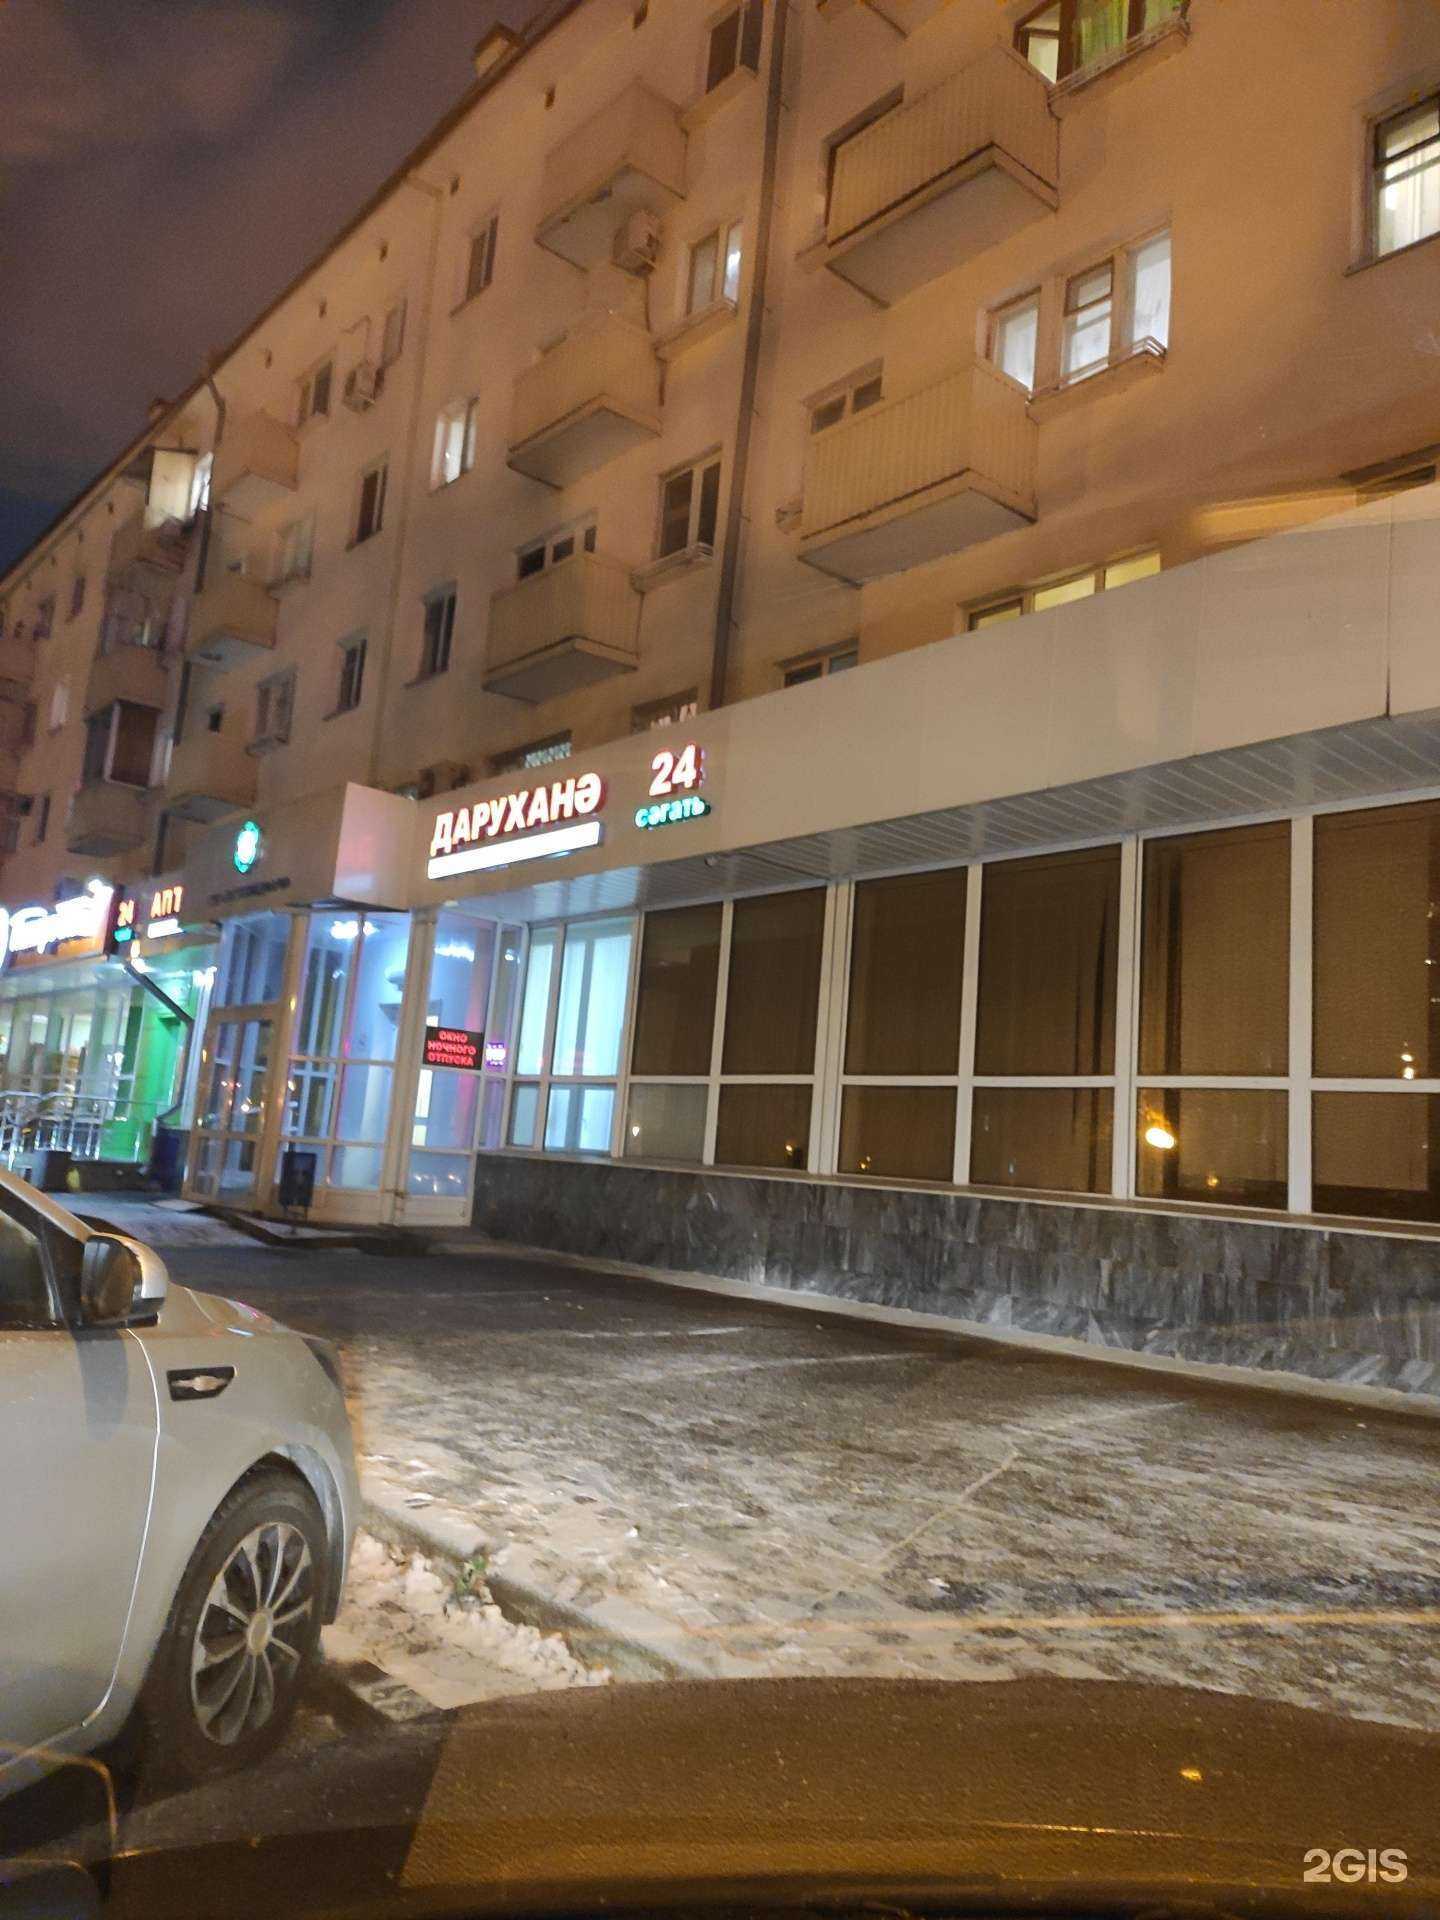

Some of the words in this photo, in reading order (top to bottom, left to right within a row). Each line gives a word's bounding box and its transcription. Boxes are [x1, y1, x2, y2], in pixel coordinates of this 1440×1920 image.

[649, 744, 698, 797] 24
[430, 772, 602, 857] ДАРУХАНӘ
[438, 1029, 468, 1043] ОКНО
[427, 1039, 476, 1056] НОЧНОГО
[427, 1051, 474, 1067] ОТПУСКА
